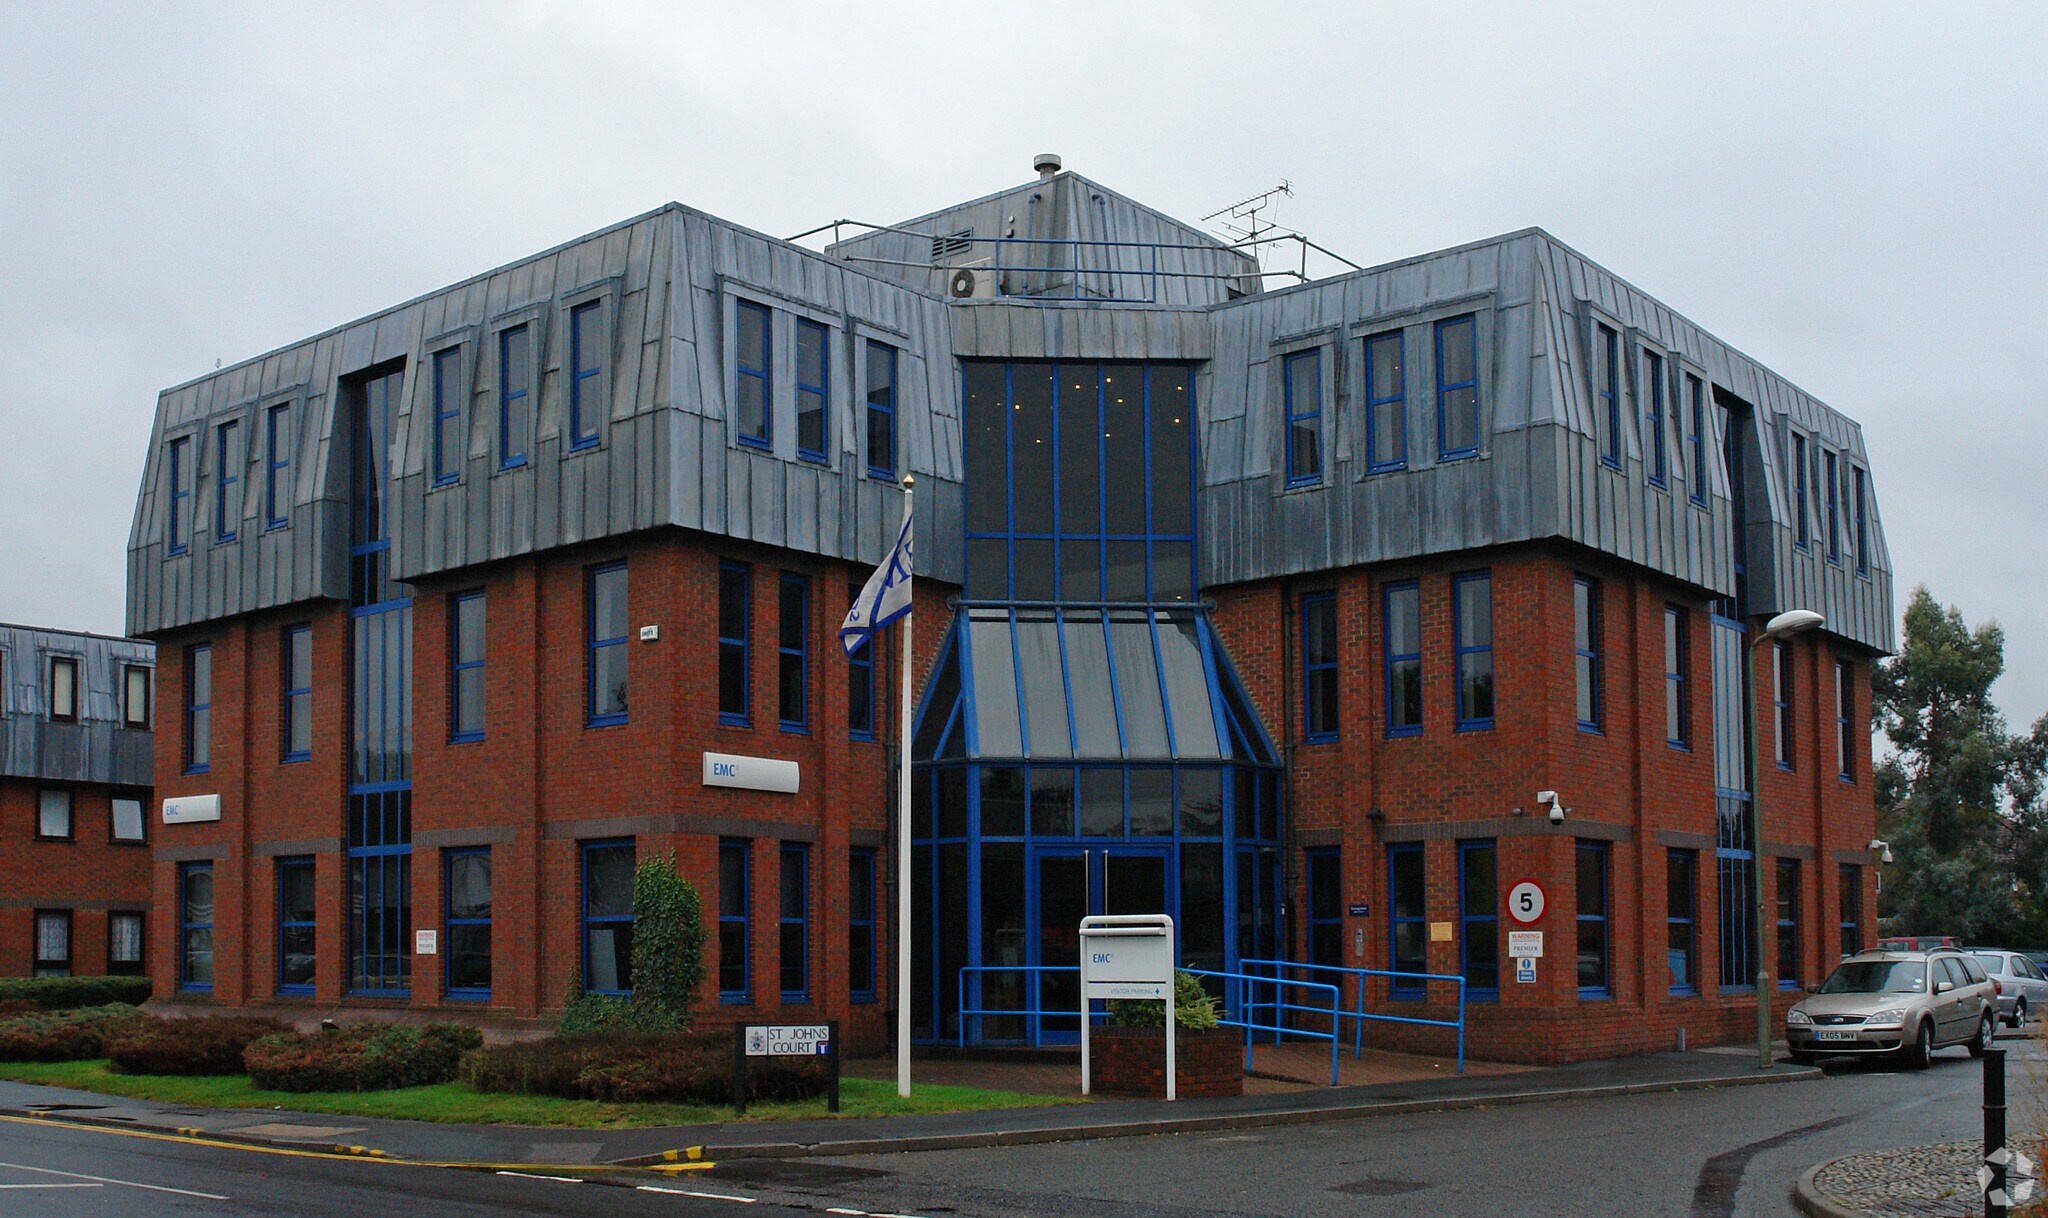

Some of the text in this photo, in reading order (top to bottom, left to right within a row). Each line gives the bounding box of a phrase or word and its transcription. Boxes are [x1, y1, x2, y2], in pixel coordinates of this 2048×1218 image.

[1520, 892, 1533, 912] 5
[769, 1028, 828, 1040] ST JOHNS
[772, 1042, 812, 1053] COURT
